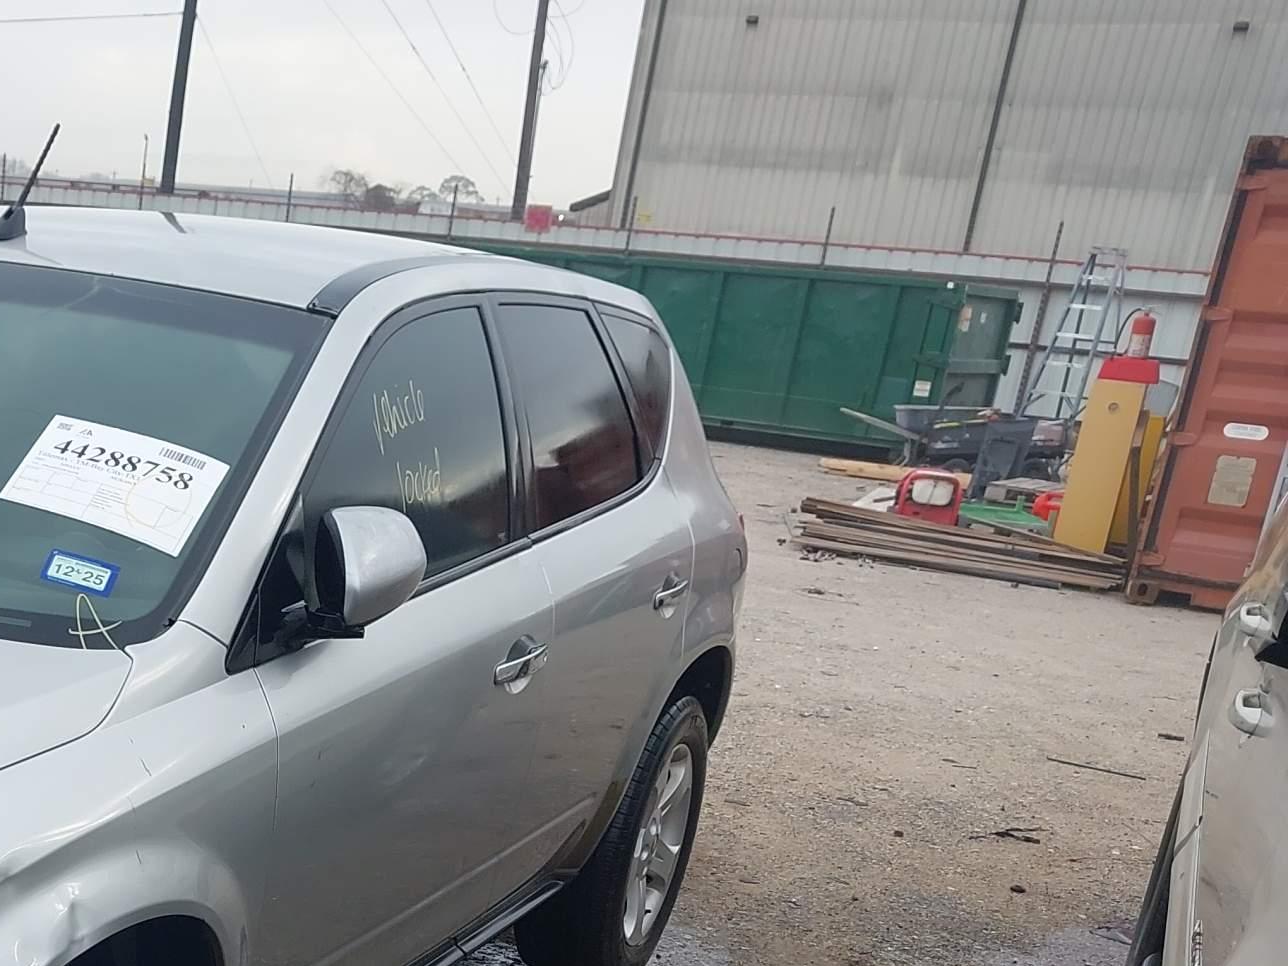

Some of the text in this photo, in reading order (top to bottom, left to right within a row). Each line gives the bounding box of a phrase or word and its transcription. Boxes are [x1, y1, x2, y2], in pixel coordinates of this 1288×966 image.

[53, 439, 194, 490] 44288758
[54, 563, 105, 586] 12 25
